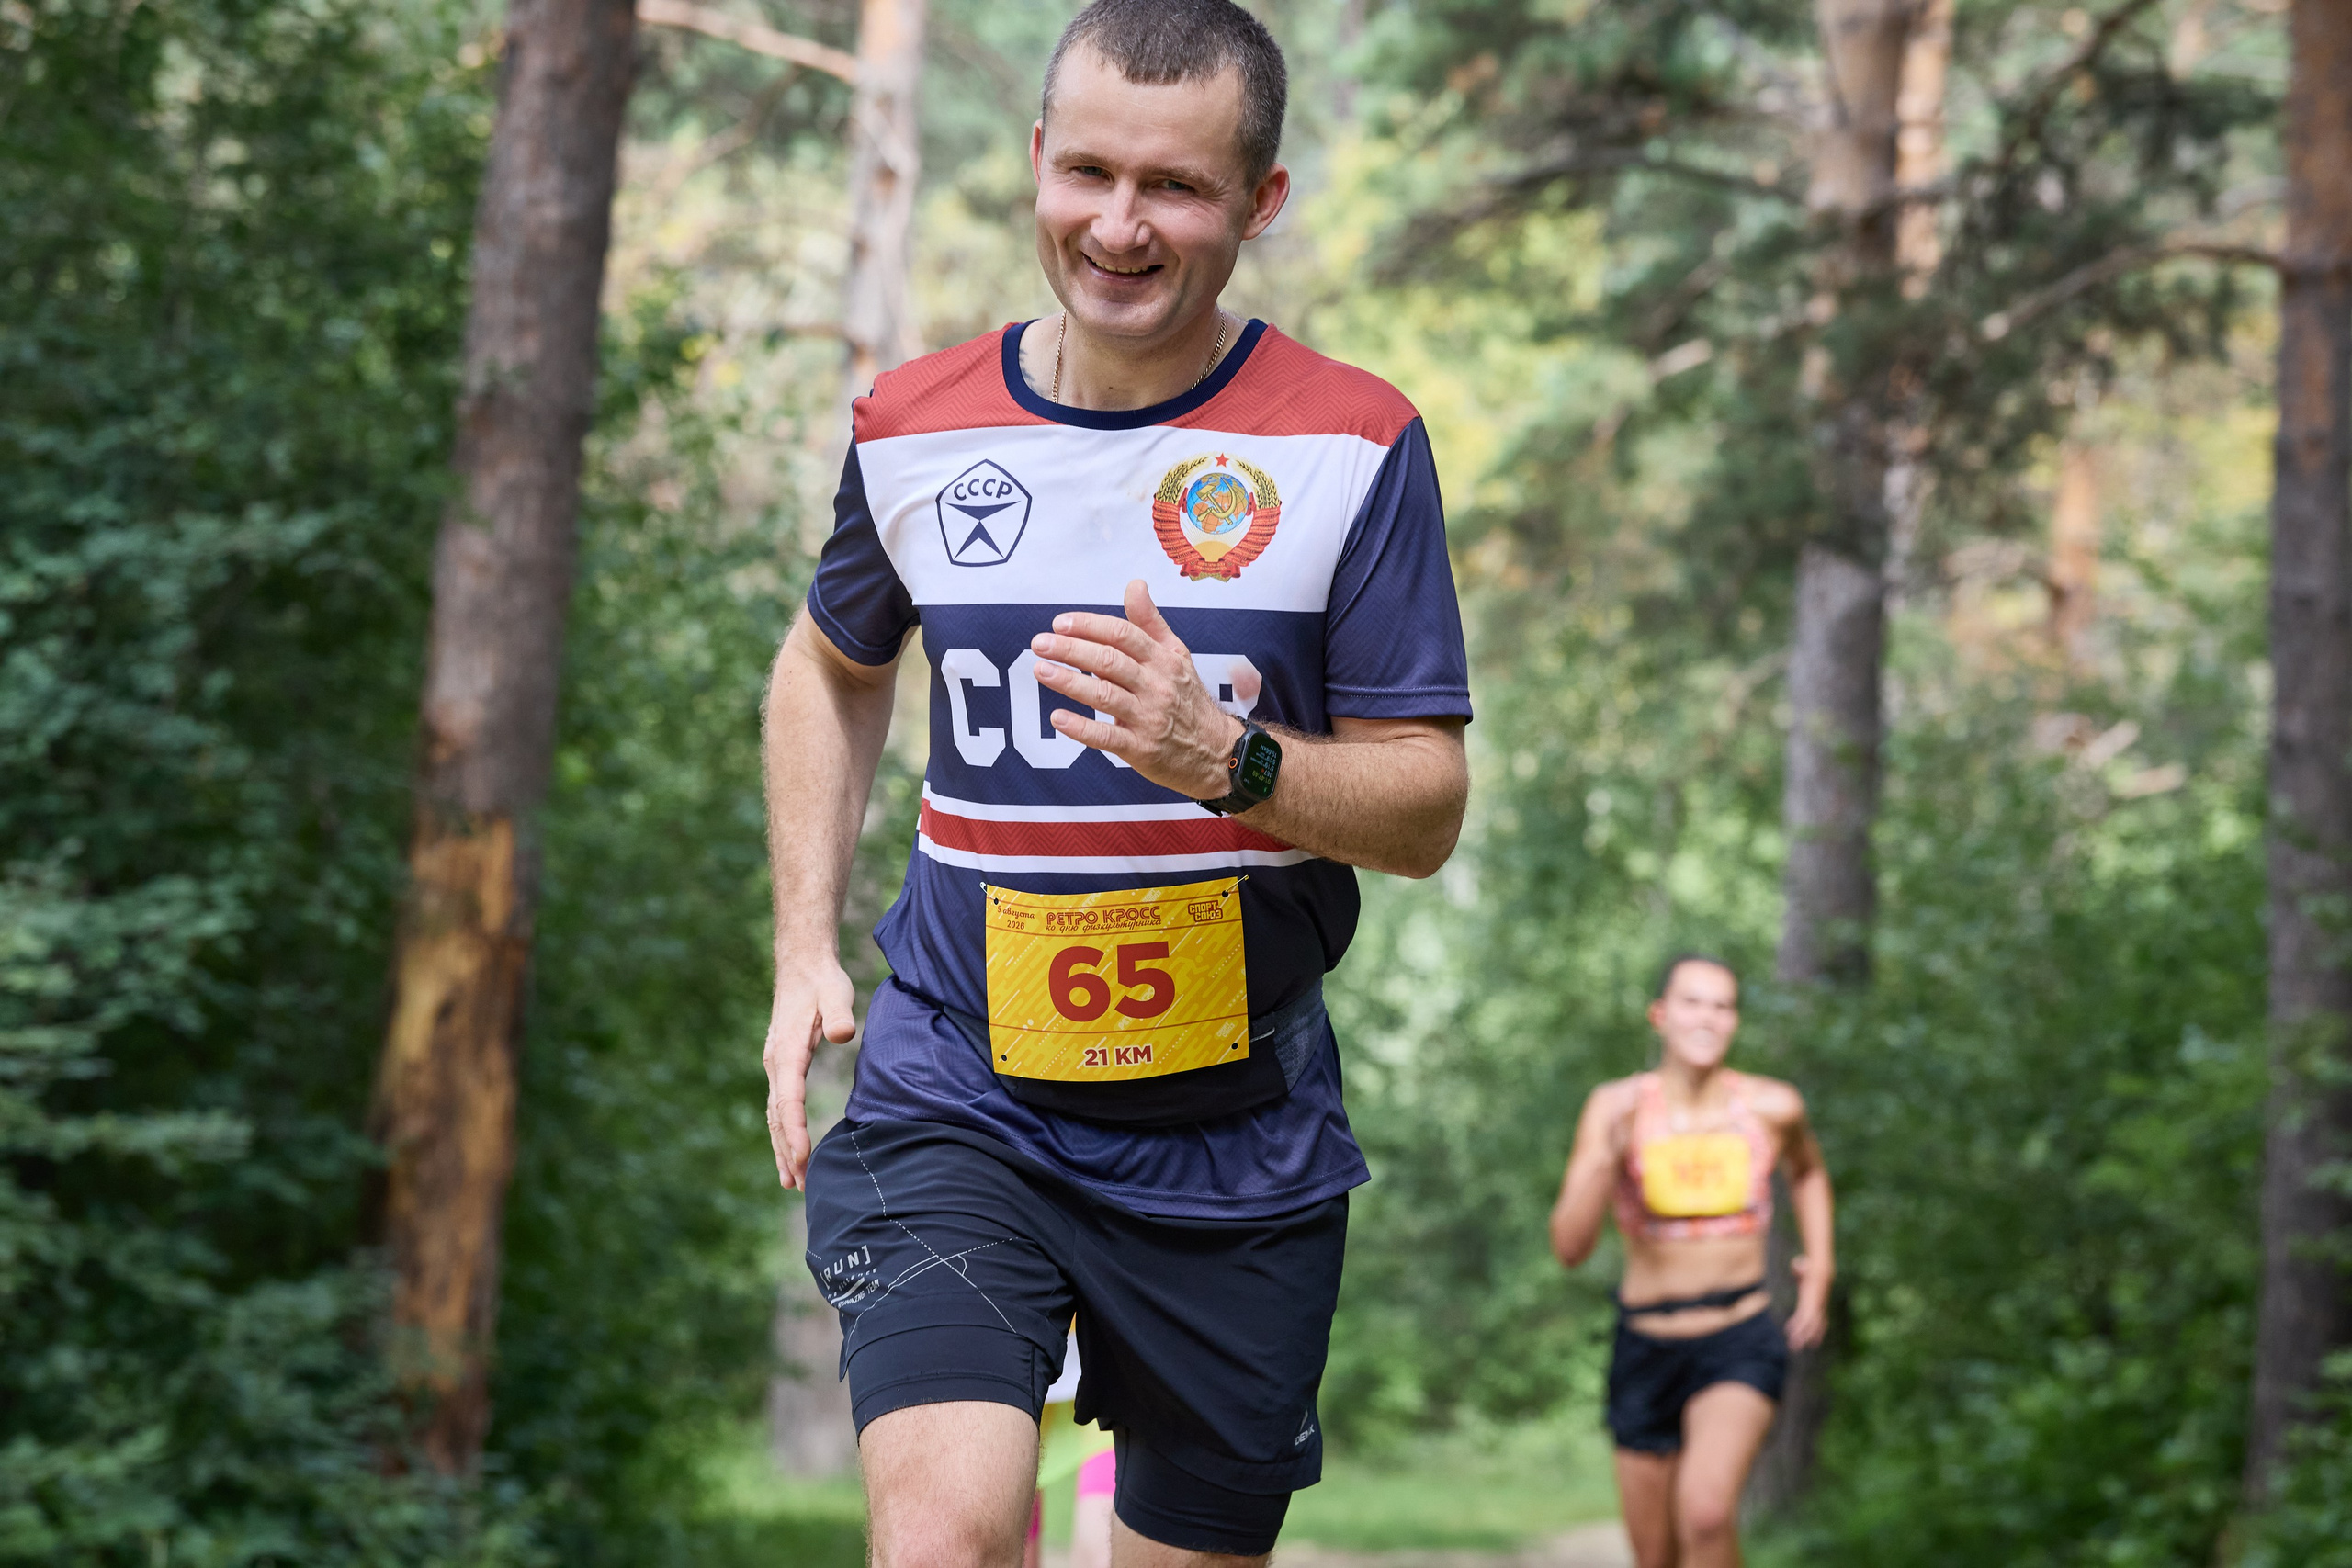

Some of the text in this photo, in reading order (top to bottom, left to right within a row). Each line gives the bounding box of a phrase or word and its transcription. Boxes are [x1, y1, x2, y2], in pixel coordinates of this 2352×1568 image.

[954, 478, 1012, 501] СССР
[940, 649, 1262, 769] ССР
[997, 905, 1035, 919] 9 августа
[1189, 901, 1217, 913] СПОРТ
[1194, 909, 1222, 921] СОЮЗ
[1046, 905, 1161, 926] РЕТРО КРОСС
[1007, 919, 1025, 931] 2026
[1059, 925, 1079, 934] дню
[1082, 919, 1161, 933] физкультурника
[1048, 941, 1176, 1022] 65
[1084, 1045, 1152, 1066] 21 КМ
[867, 1278, 880, 1294] TEAM
